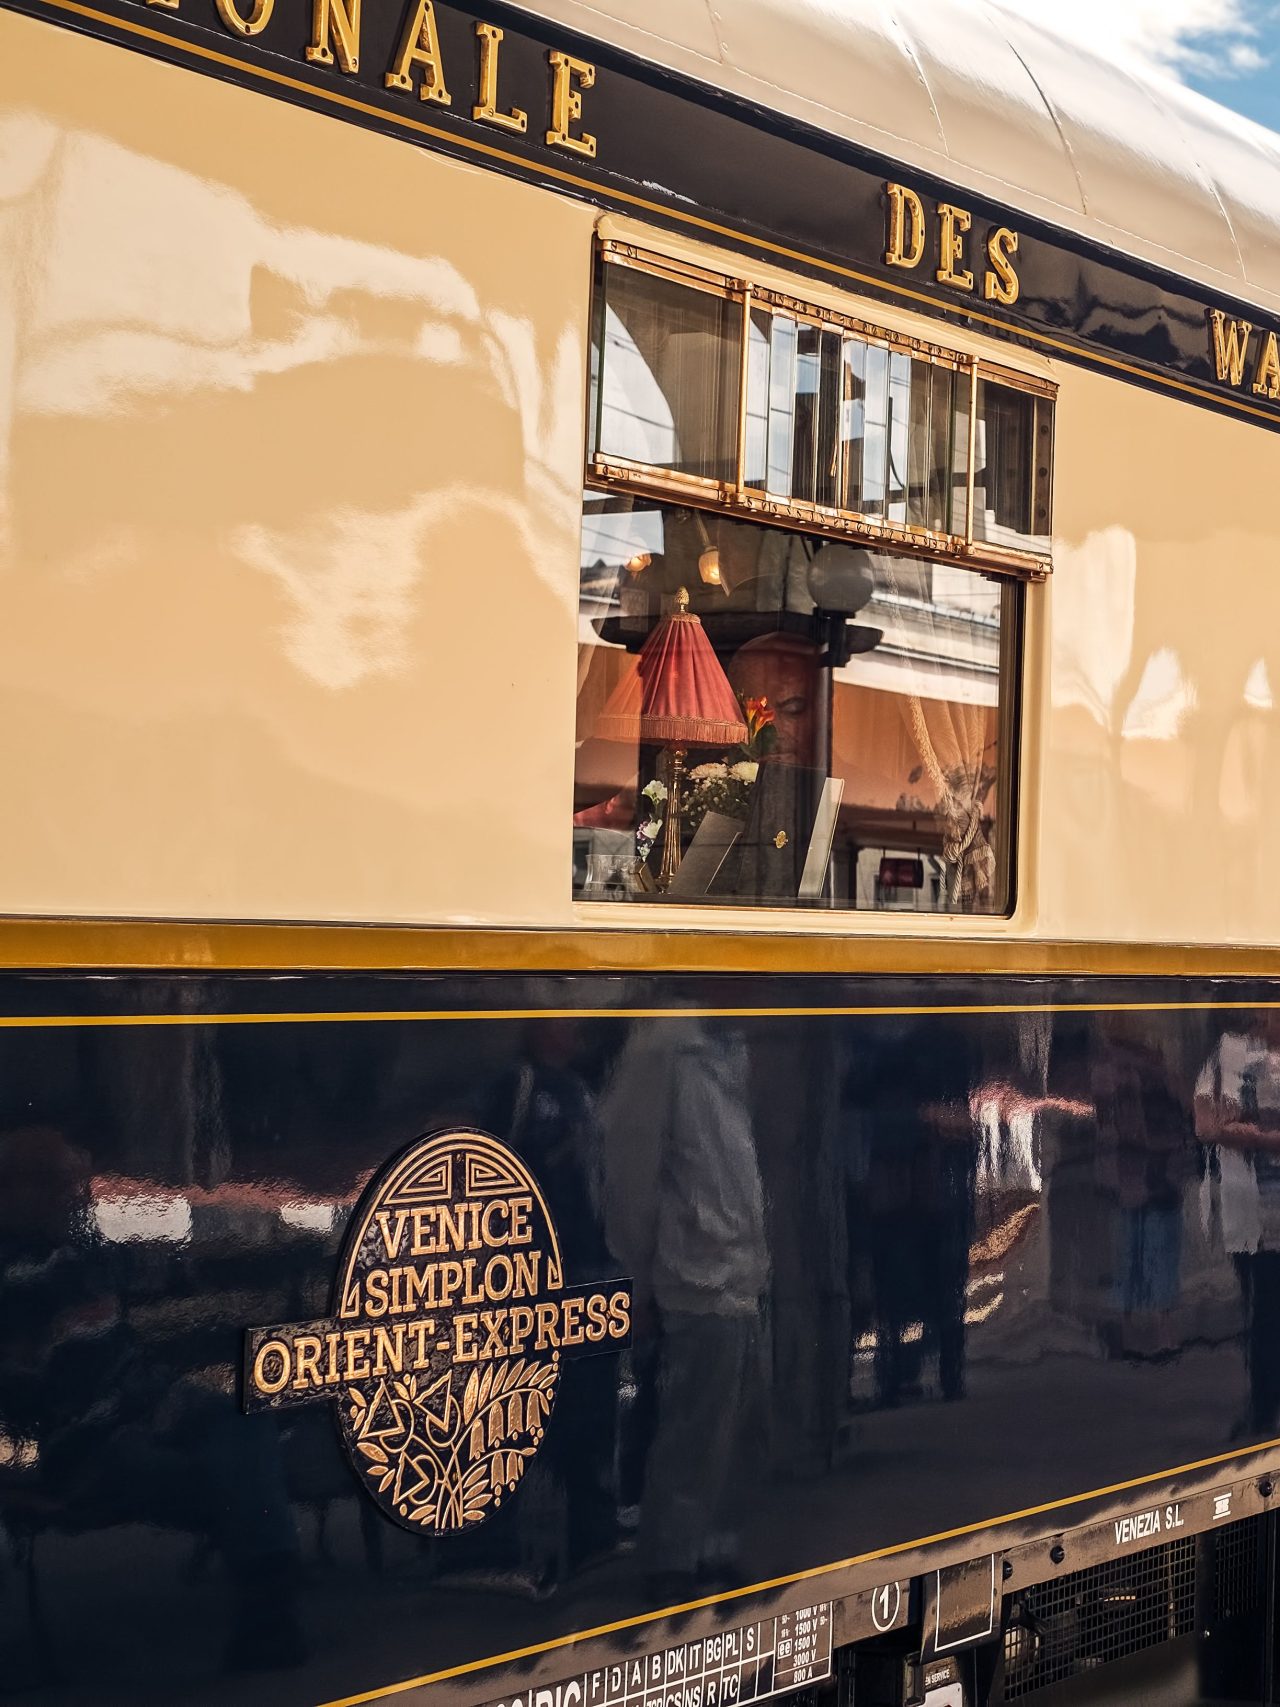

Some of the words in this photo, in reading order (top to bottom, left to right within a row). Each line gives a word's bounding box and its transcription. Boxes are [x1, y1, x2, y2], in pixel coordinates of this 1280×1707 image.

[885, 182, 1020, 305] DES
[375, 1197, 533, 1260] VENICE
[366, 1251, 542, 1318] SIMPLON
[254, 1291, 631, 1395] ORIENT-EXPRESS
[1115, 1510, 1161, 1545] VENEZIA
[1165, 1504, 1184, 1530] S.L.
[795, 1620, 811, 1636] 1500
[812, 1617, 818, 1631] V
[796, 1607, 811, 1621] 1000
[813, 1605, 818, 1616] V
[793, 1650, 810, 1667] 3000
[811, 1648, 816, 1661] V
[794, 1635, 811, 1651] 1500
[812, 1633, 817, 1646] V
[592, 1672, 600, 1698] F
[611, 1667, 621, 1692] D
[631, 1661, 642, 1686] A
[651, 1654, 662, 1680] B
[667, 1647, 684, 1676] DK
[689, 1643, 701, 1670] IT
[706, 1638, 722, 1664] BG
[725, 1632, 739, 1658] PL
[746, 1627, 755, 1652] S
[793, 1668, 806, 1684] 800
[807, 1666, 813, 1679] A
[707, 1681, 716, 1706] R
[723, 1673, 739, 1700] TC
